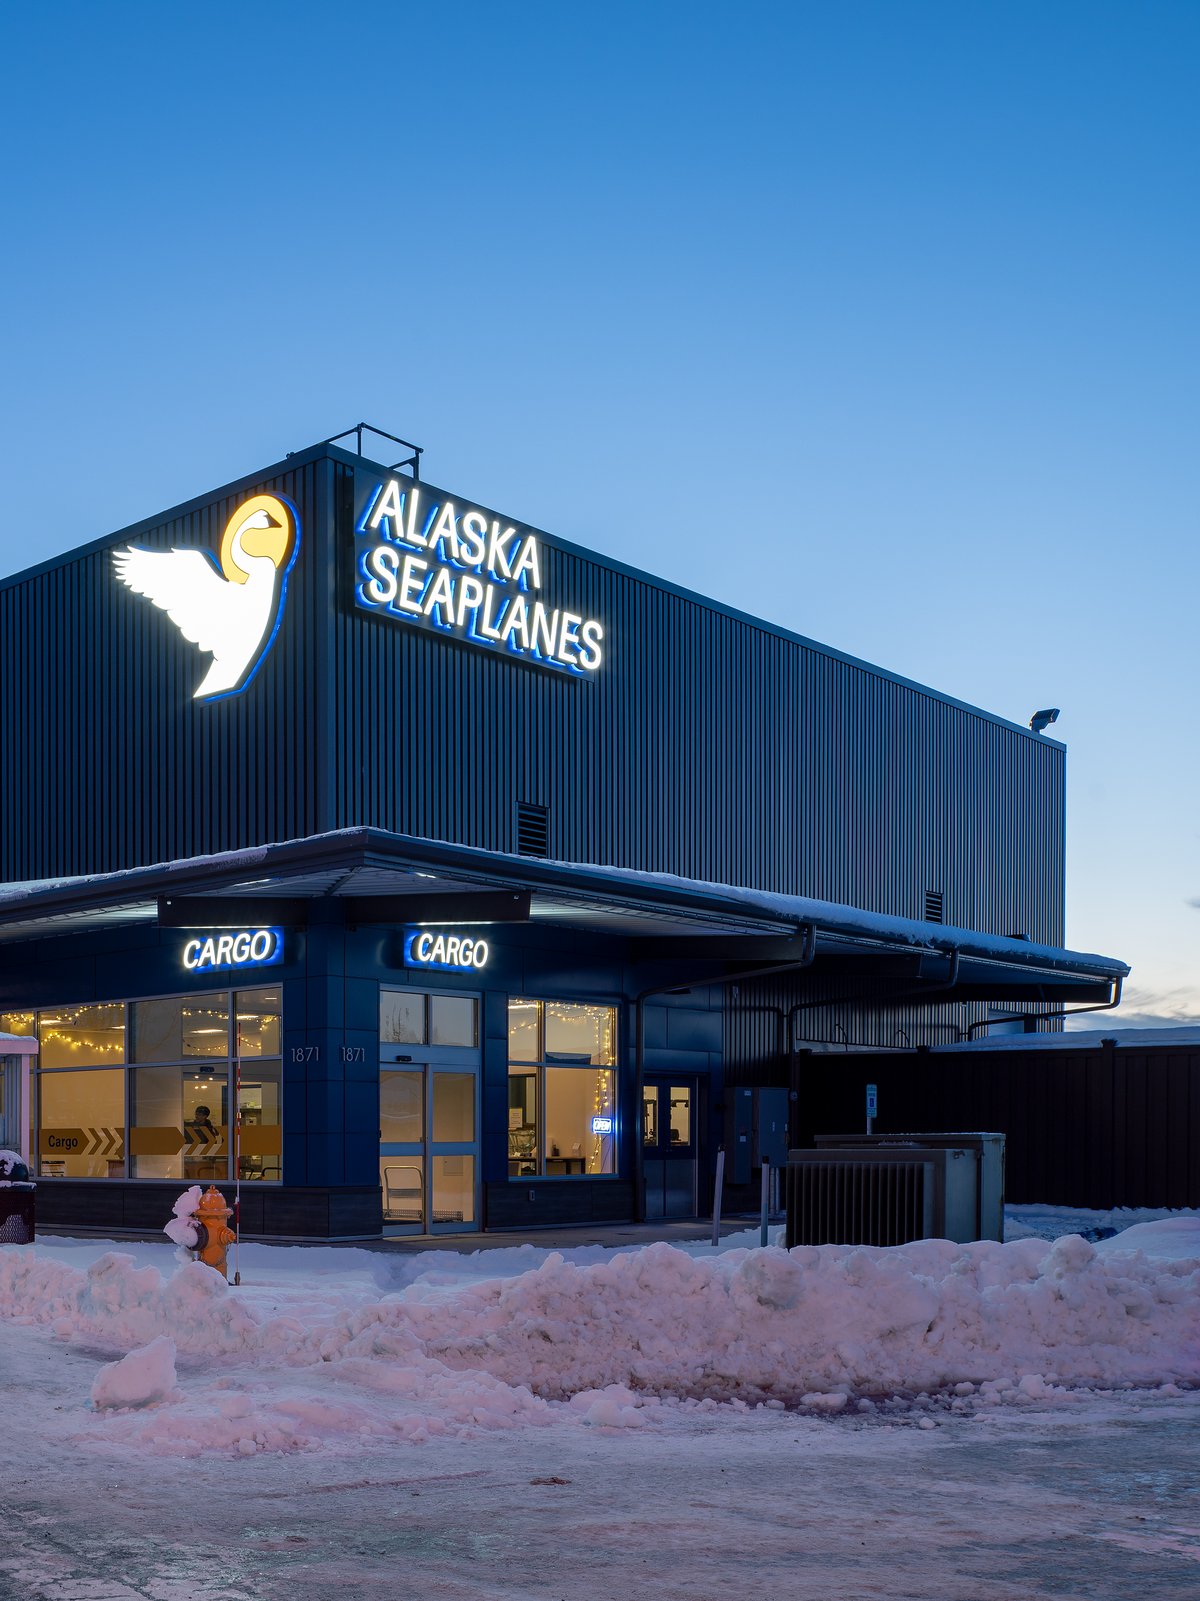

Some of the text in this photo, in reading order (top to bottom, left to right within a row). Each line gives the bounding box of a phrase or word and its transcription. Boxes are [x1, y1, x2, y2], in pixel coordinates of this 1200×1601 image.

[369, 479, 542, 590] ALASKA
[368, 545, 604, 671] SEAPLANES
[183, 930, 271, 969] CARGO
[417, 932, 489, 968] CARGO
[291, 1046, 319, 1063] 1871
[341, 1046, 365, 1063] 1871
[48, 1134, 79, 1151] Cargo
